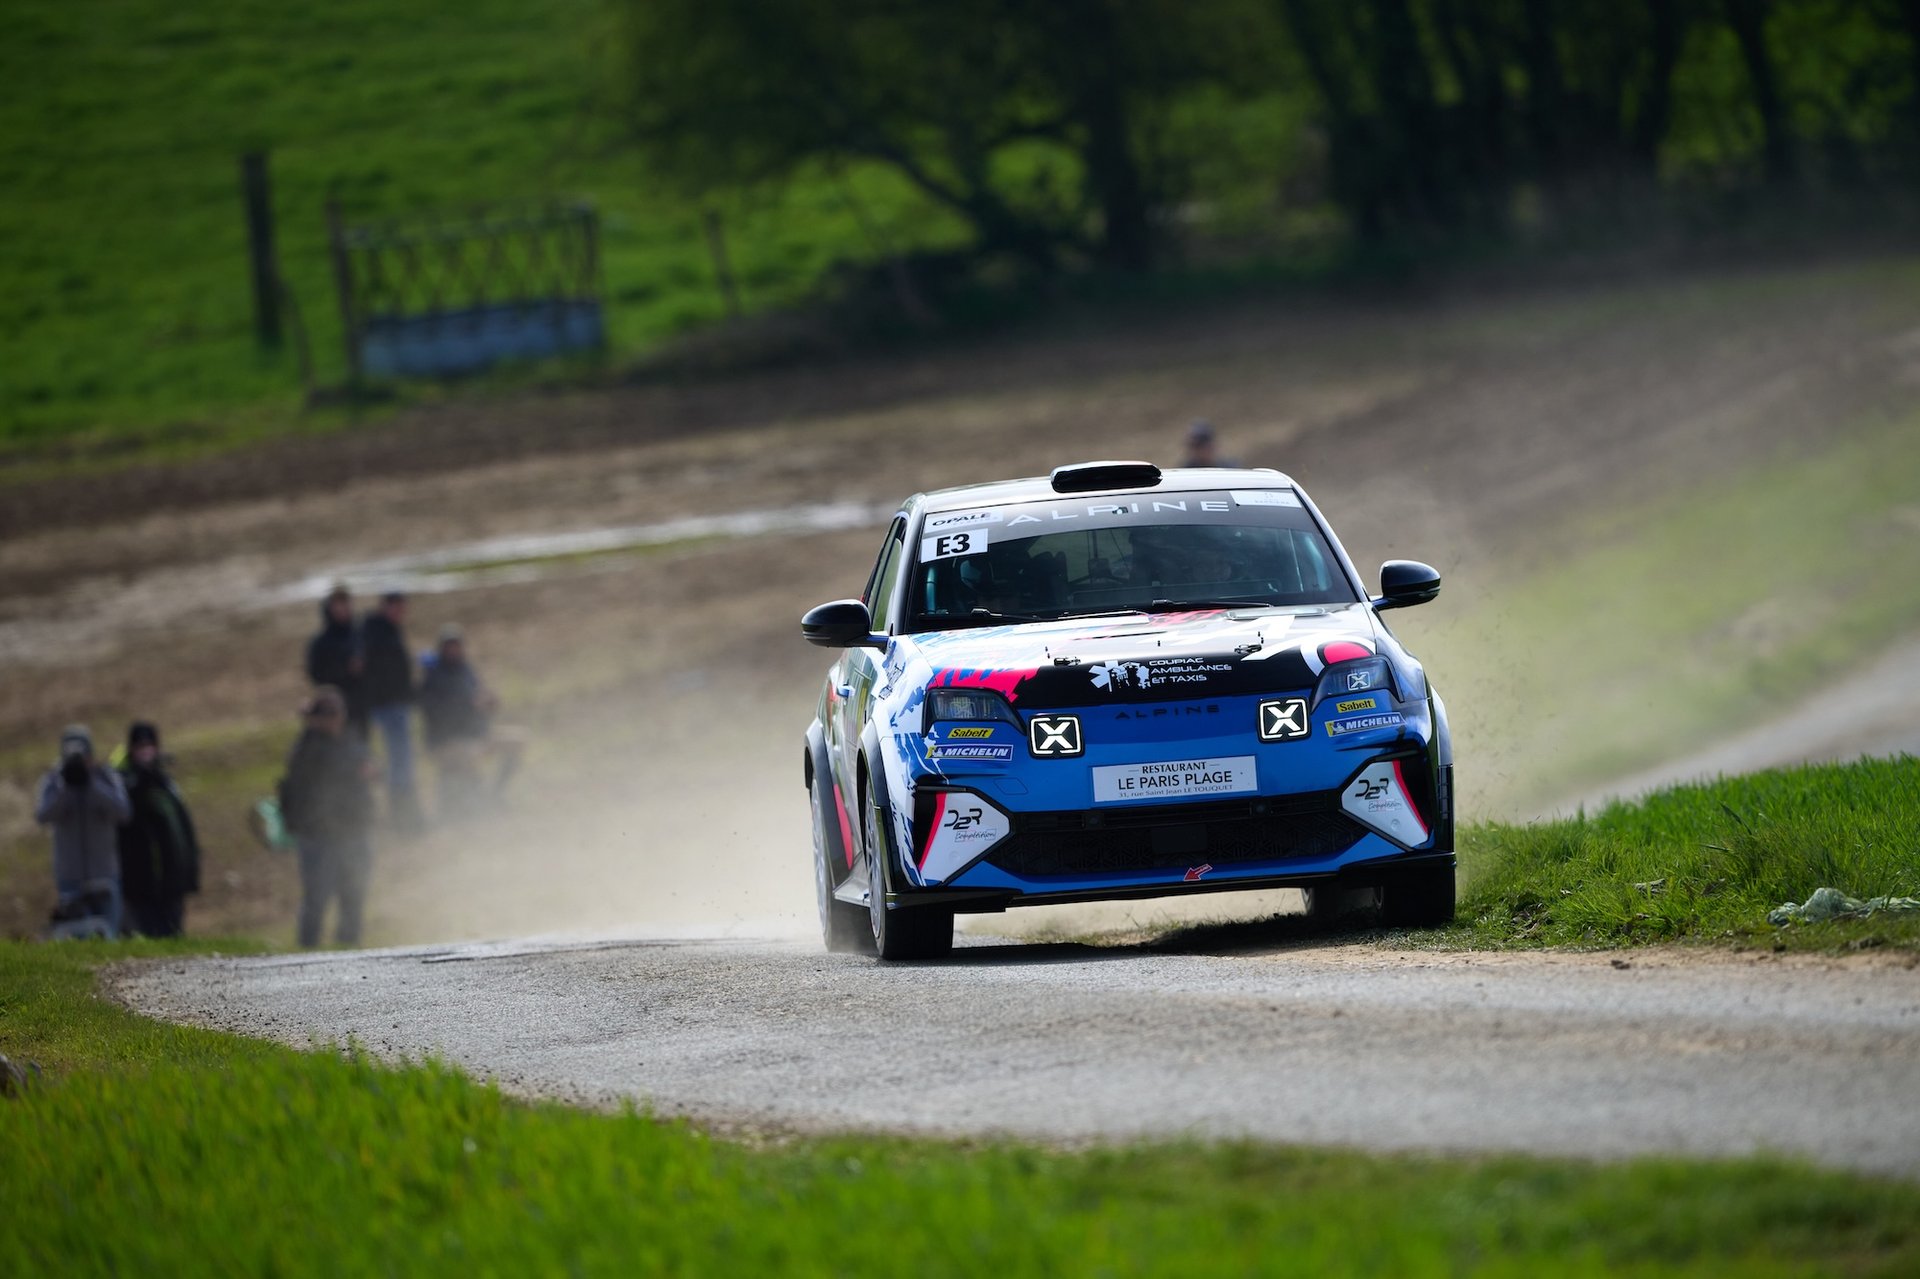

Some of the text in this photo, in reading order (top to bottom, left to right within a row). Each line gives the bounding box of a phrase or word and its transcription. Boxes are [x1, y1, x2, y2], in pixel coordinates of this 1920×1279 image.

[932, 512, 991, 527] OPALE
[1006, 500, 1230, 527] ALPINE
[936, 533, 971, 557] E3
[1149, 657, 1205, 667] COUPIAC
[1152, 674, 1208, 684] ET TAXIS
[1115, 704, 1220, 720] ALPINE
[1339, 700, 1373, 712] Sabelt
[1345, 715, 1401, 730] MICHELIN
[950, 728, 990, 738] Sabelt
[944, 747, 1009, 757] MICHELIN
[1142, 761, 1207, 774] RESTAURANT
[1118, 770, 1233, 790] LE PARIS PLAGE
[1165, 788, 1182, 796] Jean
[1193, 785, 1233, 793] TOUQUET
